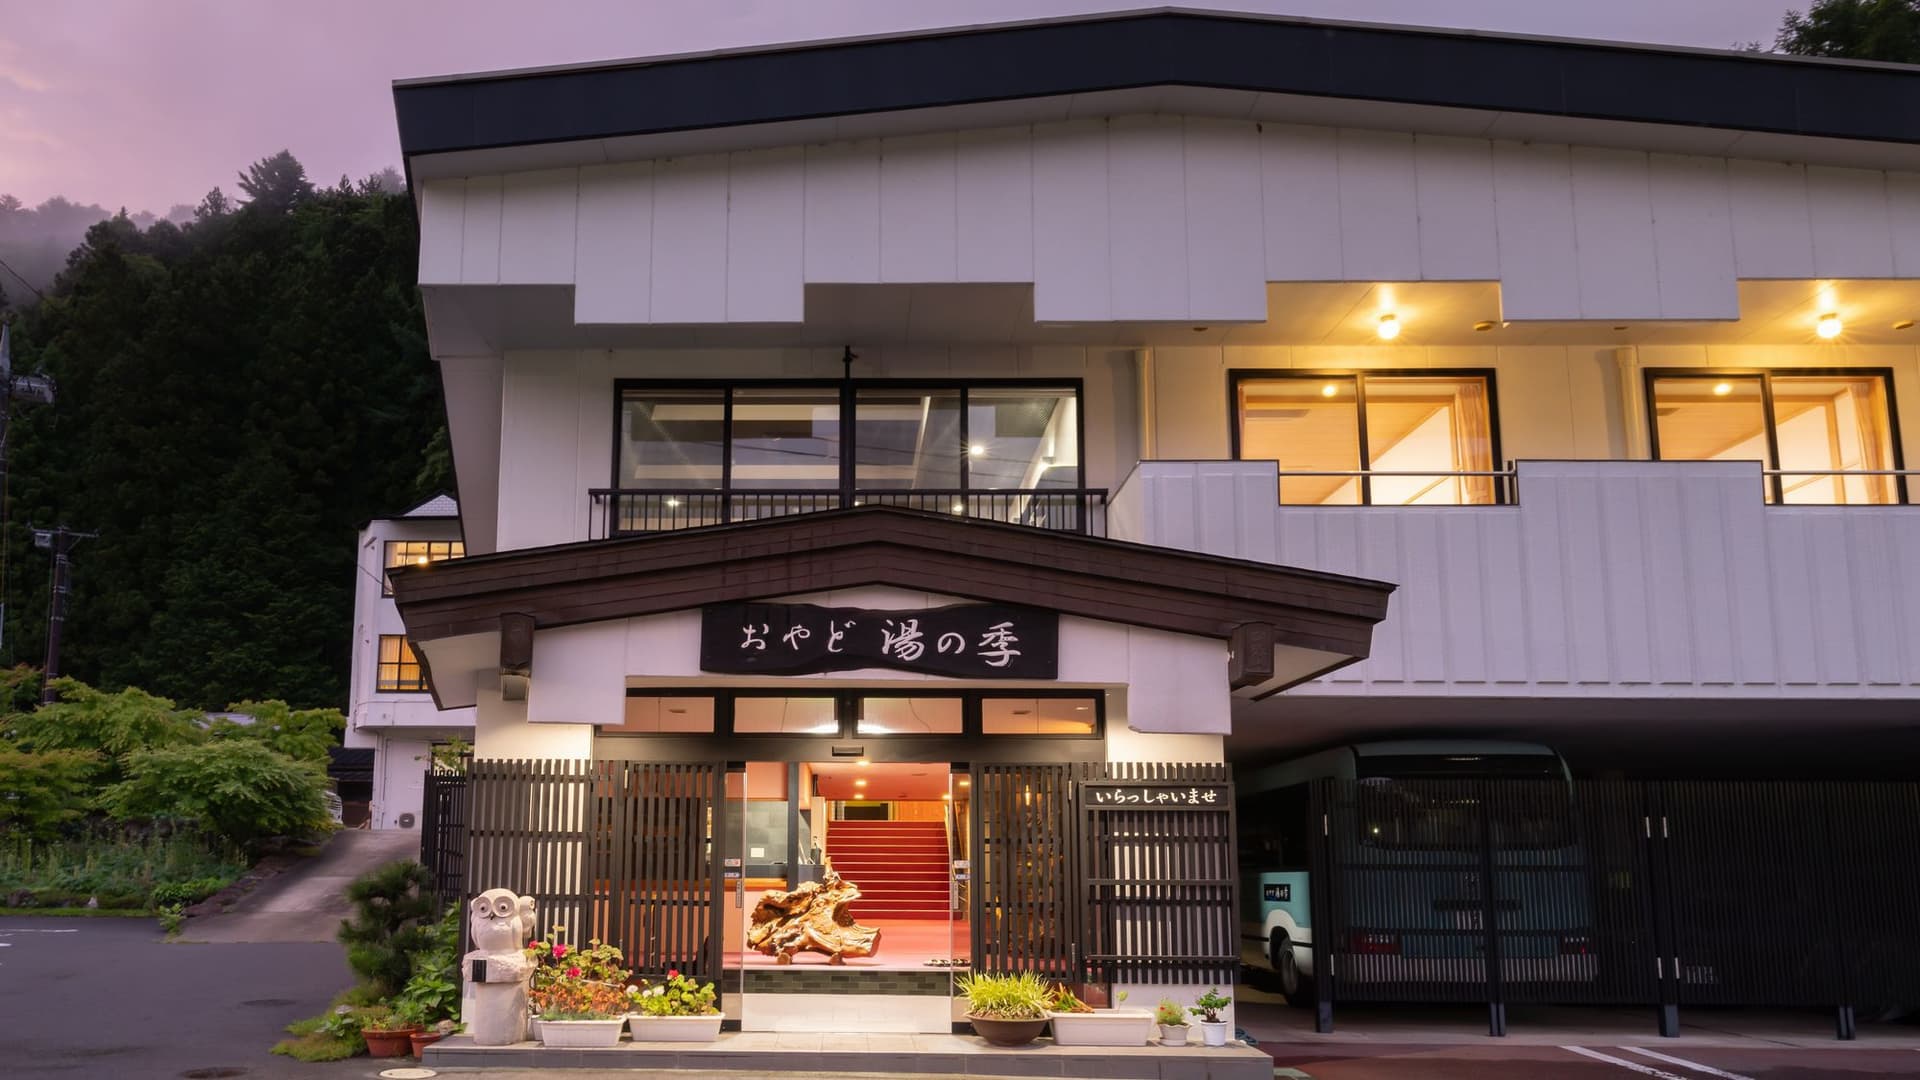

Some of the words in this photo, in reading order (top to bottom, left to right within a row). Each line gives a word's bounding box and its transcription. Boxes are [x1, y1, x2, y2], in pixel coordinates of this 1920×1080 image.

[740, 620, 857, 653] おやど
[881, 619, 1022, 667] 湯の季
[1095, 787, 1218, 805] いらっしゃいませ
